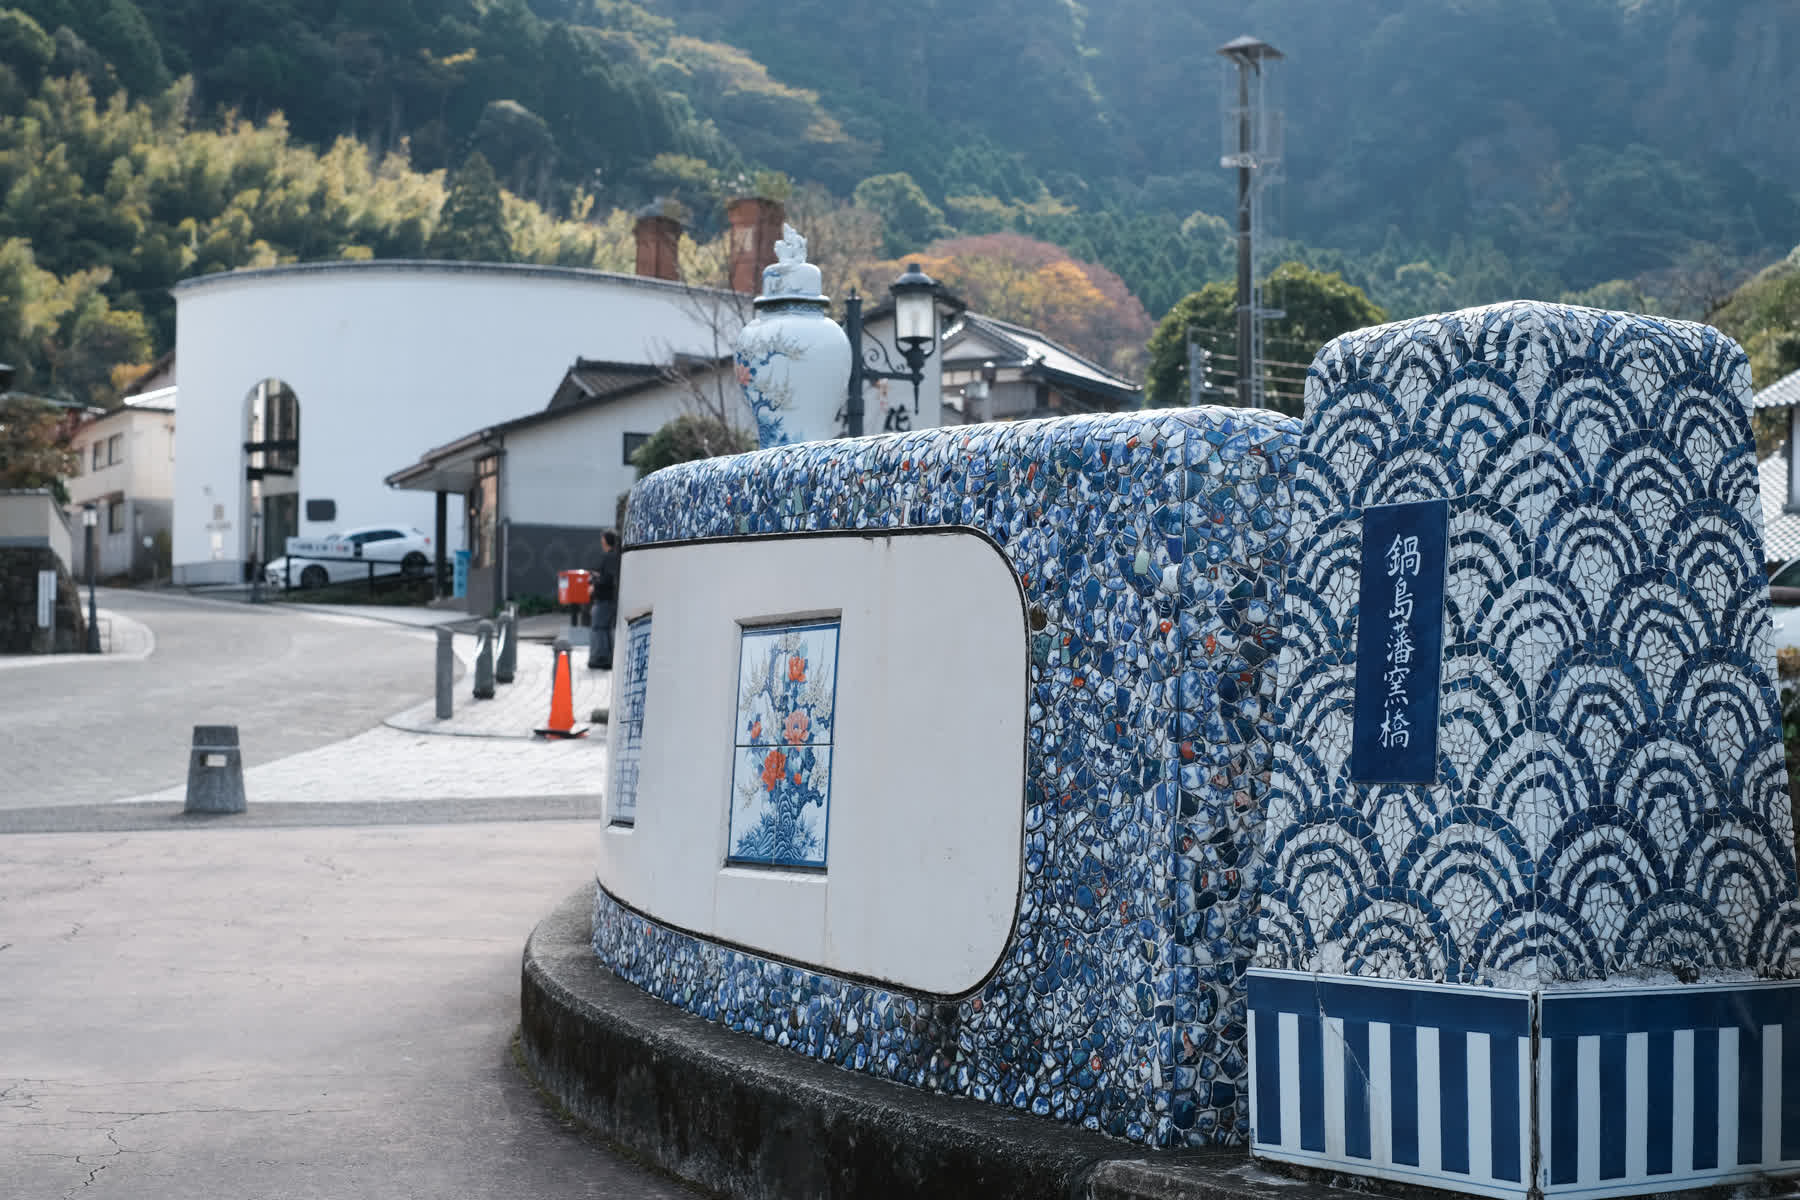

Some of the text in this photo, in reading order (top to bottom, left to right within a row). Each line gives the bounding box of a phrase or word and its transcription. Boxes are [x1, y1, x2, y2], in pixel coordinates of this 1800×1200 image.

[1377, 533, 1421, 748] 鍋島藩窯橋
